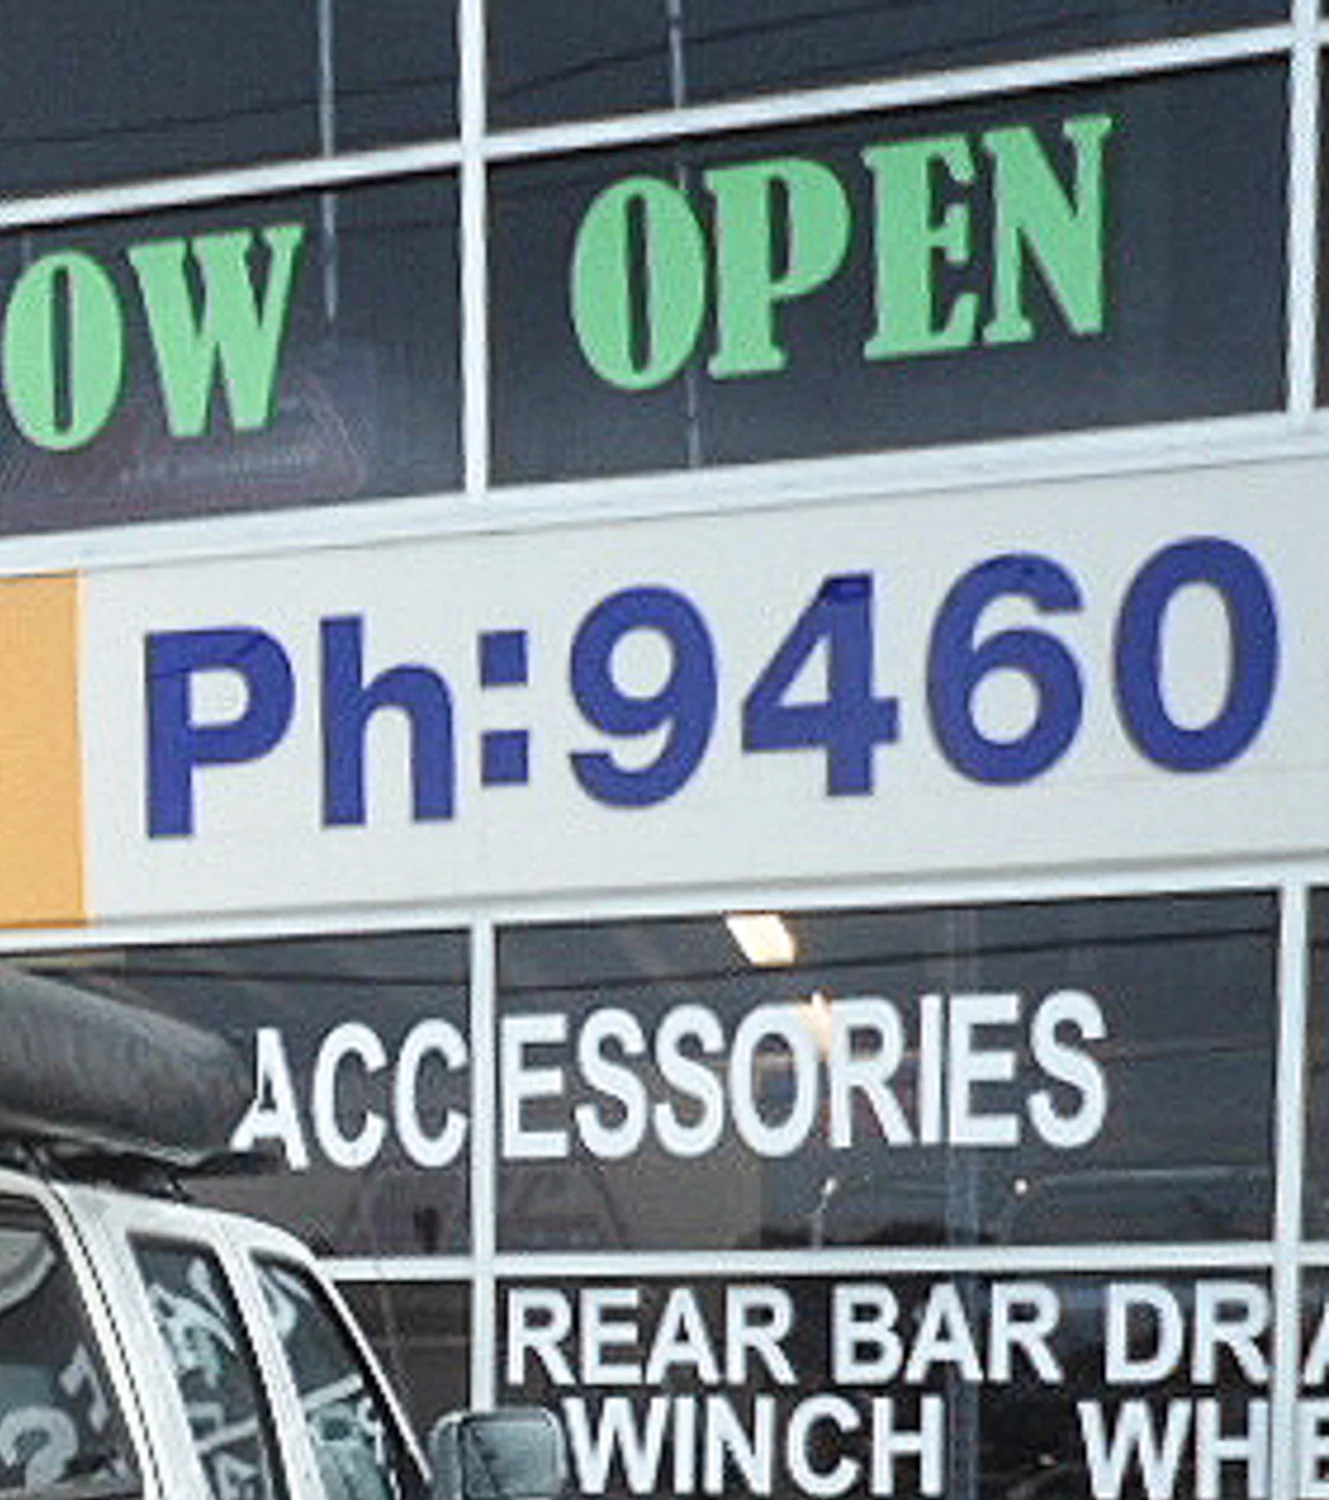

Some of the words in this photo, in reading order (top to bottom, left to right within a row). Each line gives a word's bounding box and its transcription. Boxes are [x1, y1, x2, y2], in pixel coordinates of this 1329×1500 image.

[570, 115, 1114, 390] OPEN
[144, 536, 1281, 840] Ph:9460
[230, 990, 1109, 1169] ACCESSORIES
[506, 1285, 797, 1386] REAR
[831, 1281, 1063, 1384] BAR
[562, 1395, 945, 1497] WINCH
